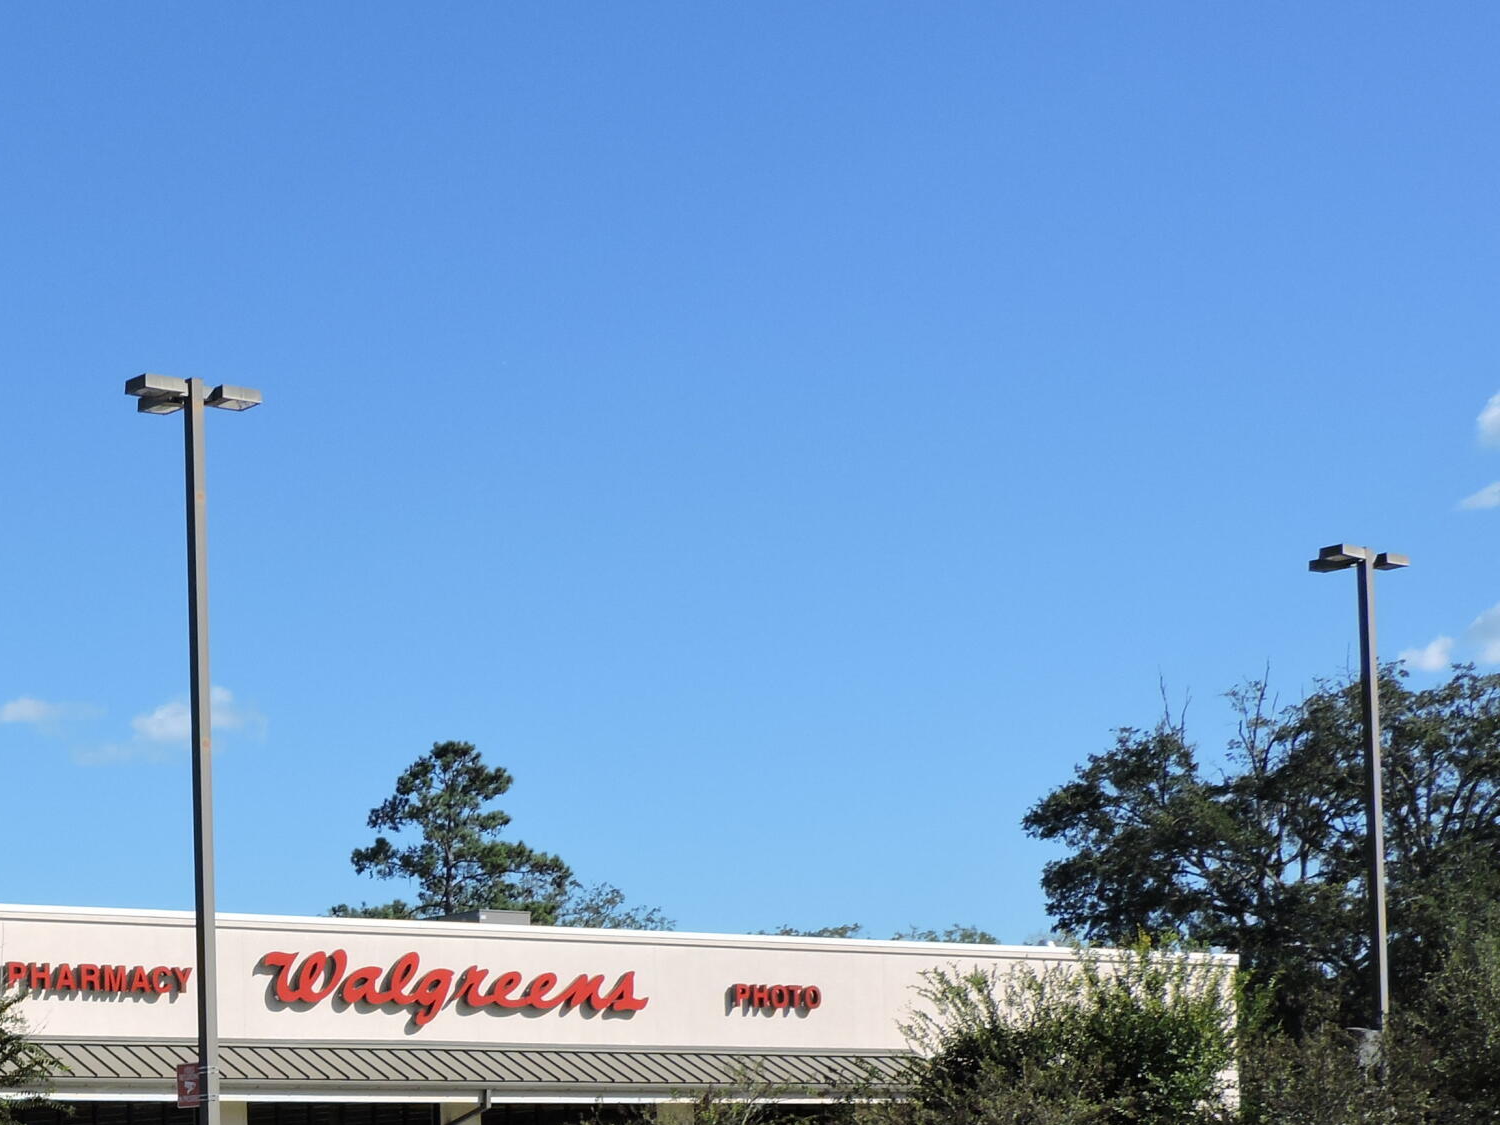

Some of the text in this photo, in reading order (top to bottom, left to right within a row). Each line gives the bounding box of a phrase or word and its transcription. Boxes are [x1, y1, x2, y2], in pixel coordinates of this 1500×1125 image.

[4, 961, 193, 994] PHARMACY
[263, 948, 649, 1026] Walgreens
[733, 983, 821, 1009] PHOTO
